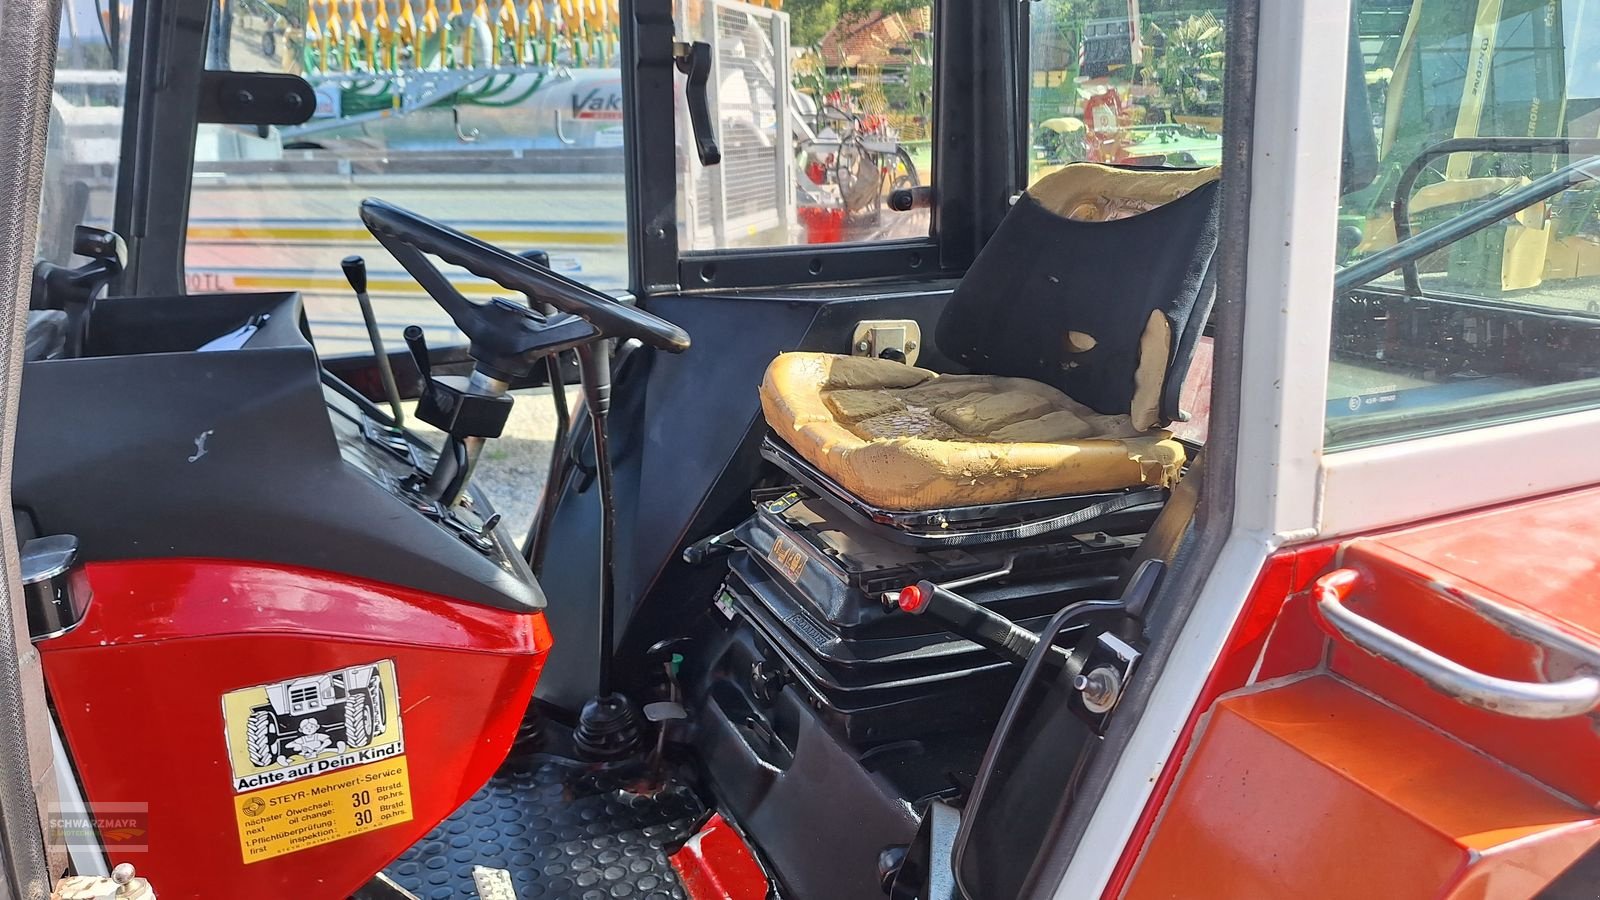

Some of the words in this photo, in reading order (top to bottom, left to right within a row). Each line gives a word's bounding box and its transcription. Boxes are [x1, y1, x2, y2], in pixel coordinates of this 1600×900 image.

[1527, 97, 1540, 138] KRONE
[238, 772, 285, 790] Achte
[288, 763, 314, 779] auf
[318, 756, 355, 771] Dein
[352, 790, 370, 808] 30
[246, 826, 265, 836] next
[288, 817, 299, 825] oil
[301, 808, 335, 822] change:
[354, 809, 373, 827] 30
[249, 845, 267, 855] first
